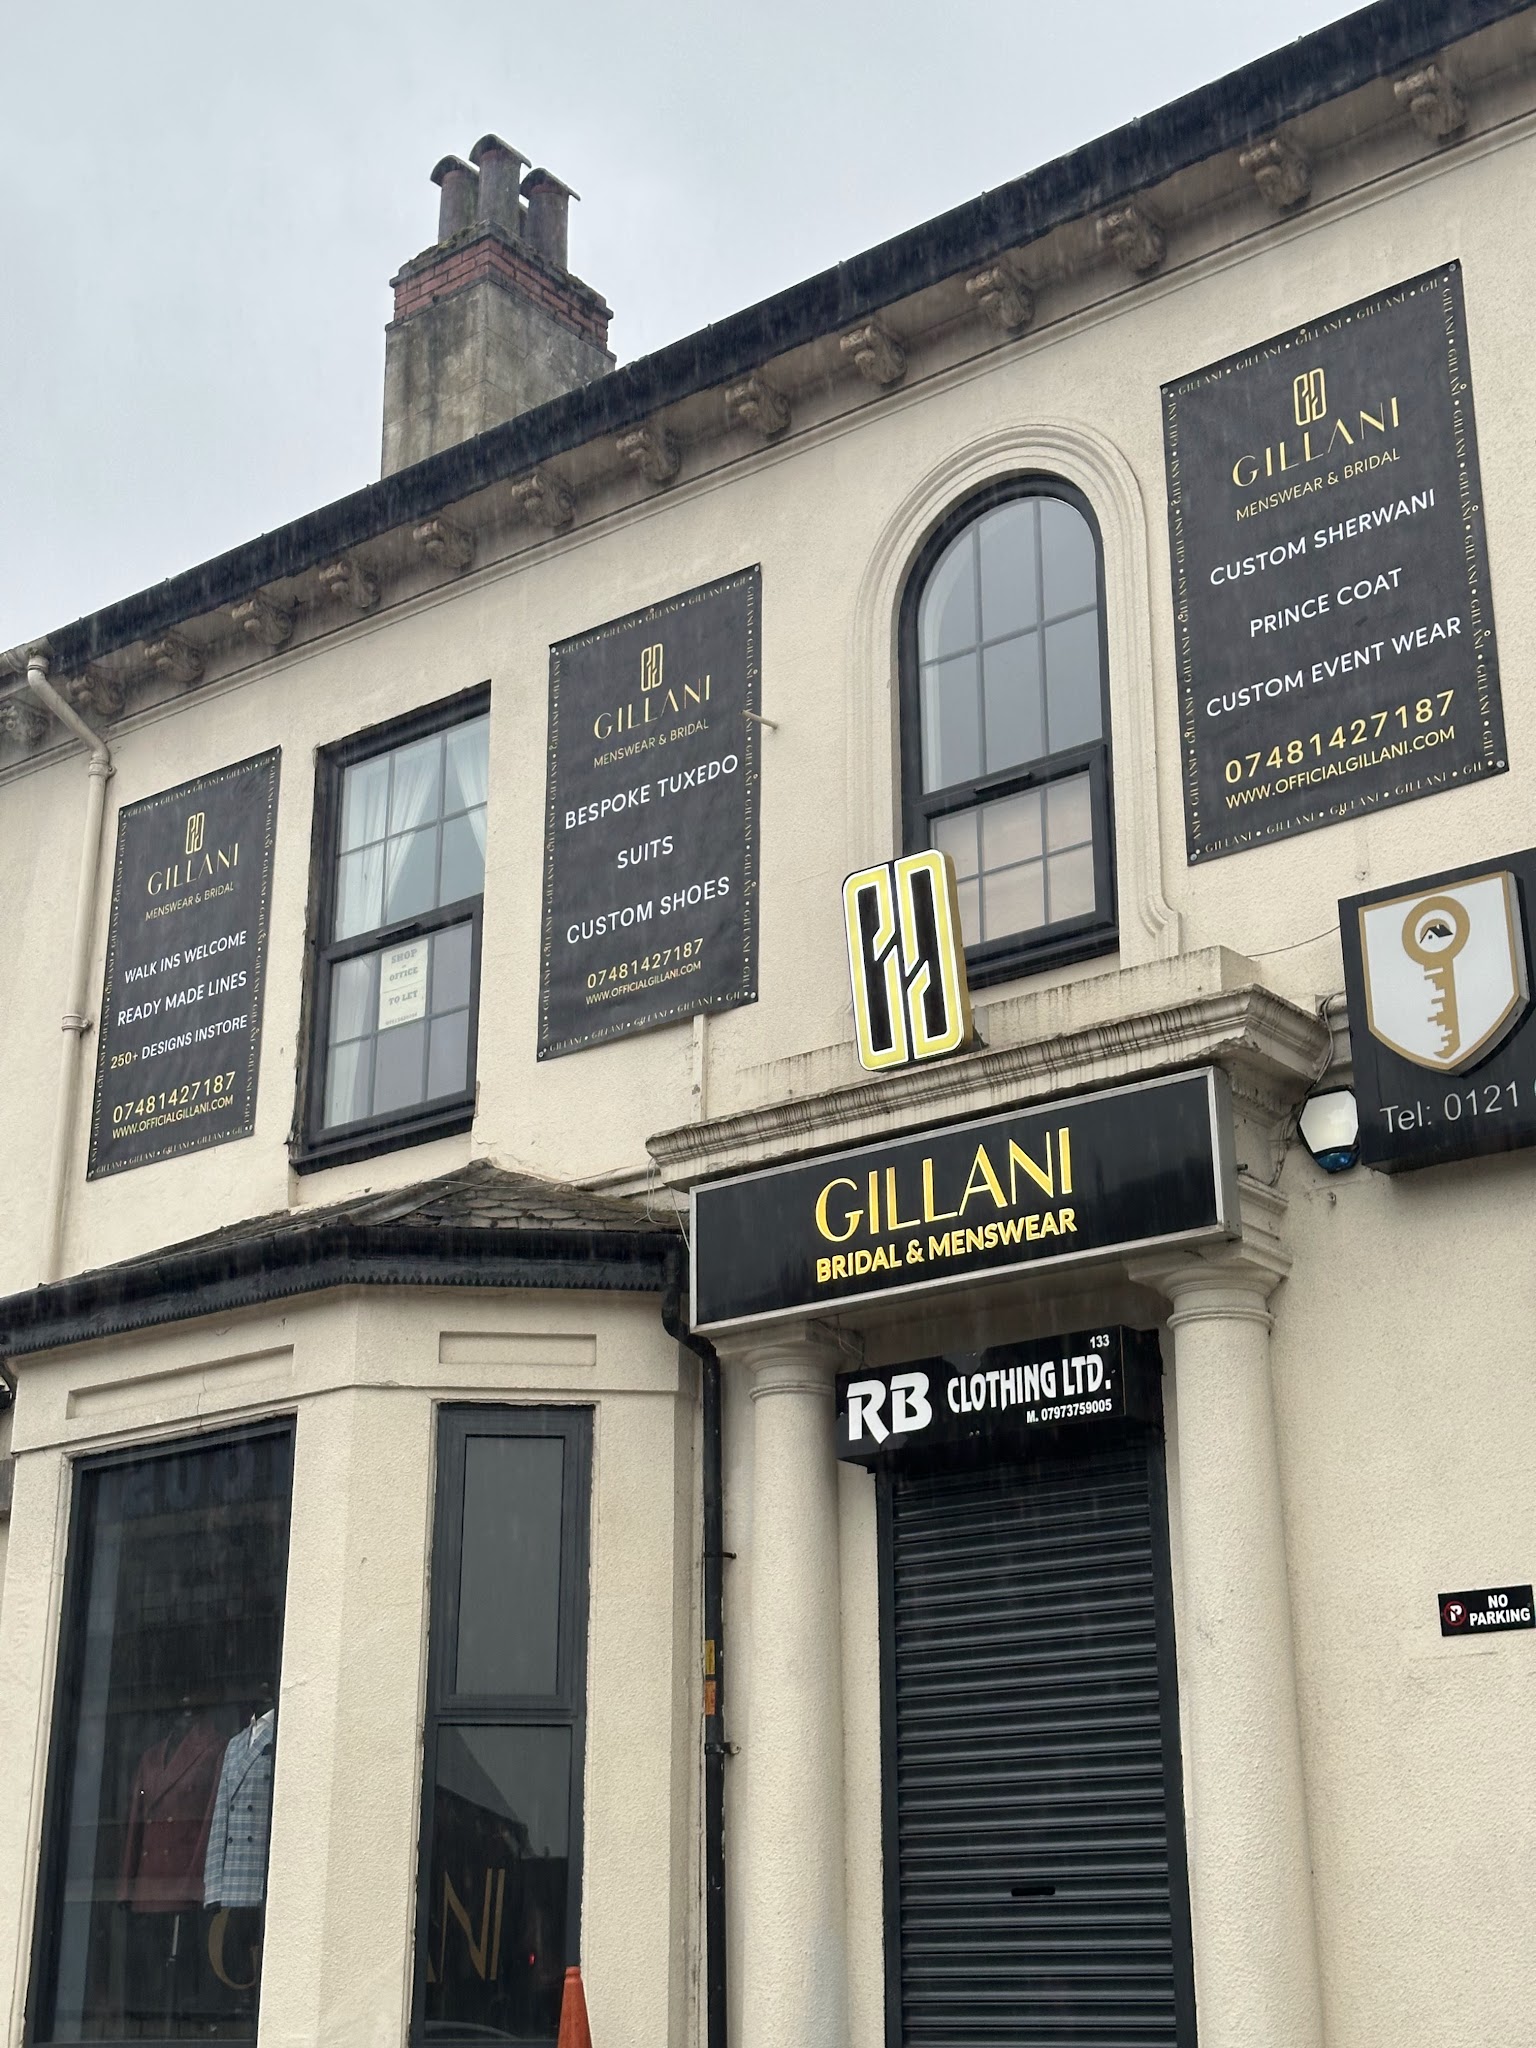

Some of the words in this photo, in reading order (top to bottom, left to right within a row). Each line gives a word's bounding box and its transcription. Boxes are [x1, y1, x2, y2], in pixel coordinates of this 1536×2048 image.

[1231, 395, 1399, 491] GILLANI
[1235, 475, 1323, 521] MENSWEAR
[1327, 469, 1338, 486] &
[1344, 446, 1400, 480] BRIDAL
[1209, 535, 1306, 589] CUSTOM
[1313, 487, 1435, 550] SHERWANI
[1249, 593, 1329, 639] PRINCE
[1336, 566, 1402, 608] COAT
[1206, 668, 1304, 719] CUSTOM
[1311, 641, 1385, 683] EVENT
[1391, 615, 1461, 656] WEAR
[593, 673, 710, 742] GILLANI
[593, 736, 654, 768] MENSWEAR
[658, 732, 666, 745] &
[670, 716, 708, 741] BRIDAL
[1224, 688, 1456, 785] 07481427187
[565, 783, 650, 830] BESPOKE
[657, 752, 738, 798] TUXEDO
[1225, 725, 1455, 810] WWW.OFFICIALGILLANI.COM
[146, 841, 239, 898] GILLANI
[617, 833, 673, 870] SUITS
[145, 894, 193, 921] MENSWEAR
[195, 891, 201, 903] &
[204, 880, 234, 900] BRIDAL
[566, 900, 652, 944] CUSTOM
[660, 875, 729, 915] SHOES
[124, 960, 157, 984] WALK
[160, 952, 180, 972] INS
[184, 929, 246, 964] WELCOME
[389, 966, 419, 981] OFFICE
[585, 960, 701, 1005] WWW.OFFICIALGILLANI.COM
[587, 937, 703, 988] 07481427187
[117, 998, 161, 1026] READY
[165, 984, 204, 1011] MADE
[208, 969, 247, 997] LINES
[388, 997, 400, 1006] TO
[402, 989, 418, 1002] LET
[110, 1048, 138, 1069] 250+
[141, 1031, 192, 1059] DESIGNS
[195, 1014, 247, 1042] INSTORE
[111, 1094, 233, 1140] WWW.OFFICIALGILLANI.COM
[112, 1071, 235, 1123] 07481427187
[1379, 1100, 1432, 1133] Tel:
[1444, 1080, 1518, 1121] 0121
[815, 1127, 1073, 1243] GILLANI
[816, 1243, 903, 1283] BRIDAL
[905, 1239, 924, 1264] &
[928, 1207, 1077, 1258] MENSWEAR
[1089, 1334, 1110, 1349] 133
[846, 1372, 933, 1444] RB
[947, 1361, 1056, 1413] CLOTHING
[1062, 1353, 1111, 1397] LTD.
[1026, 1410, 1039, 1424] M.
[1041, 1399, 1112, 1421] 07973759005
[1469, 1607, 1531, 1626] PARKING
[1488, 1594, 1509, 1609] NO
[426, 1868, 506, 1983] NI
